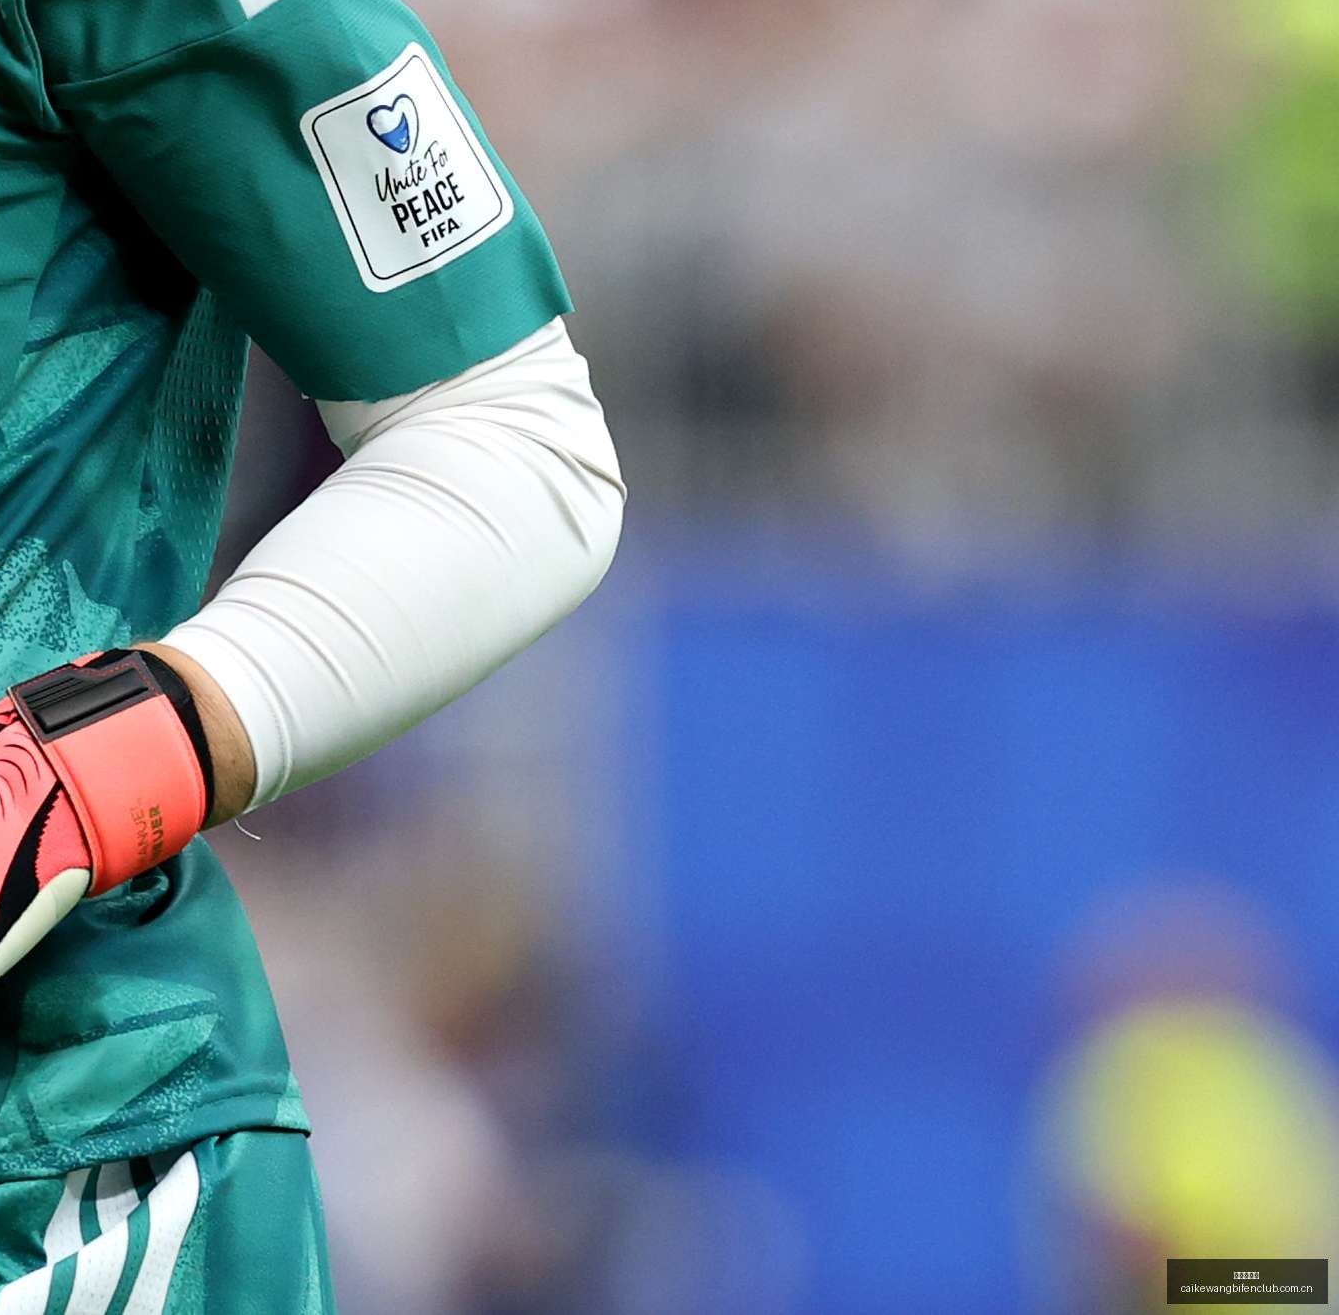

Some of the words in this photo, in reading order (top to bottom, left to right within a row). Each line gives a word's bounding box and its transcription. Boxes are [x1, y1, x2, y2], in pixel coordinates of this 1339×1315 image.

[375, 159, 427, 202] Unite
[424, 140, 449, 176] For
[391, 173, 465, 233] PEACE
[420, 217, 460, 247] FIFA
